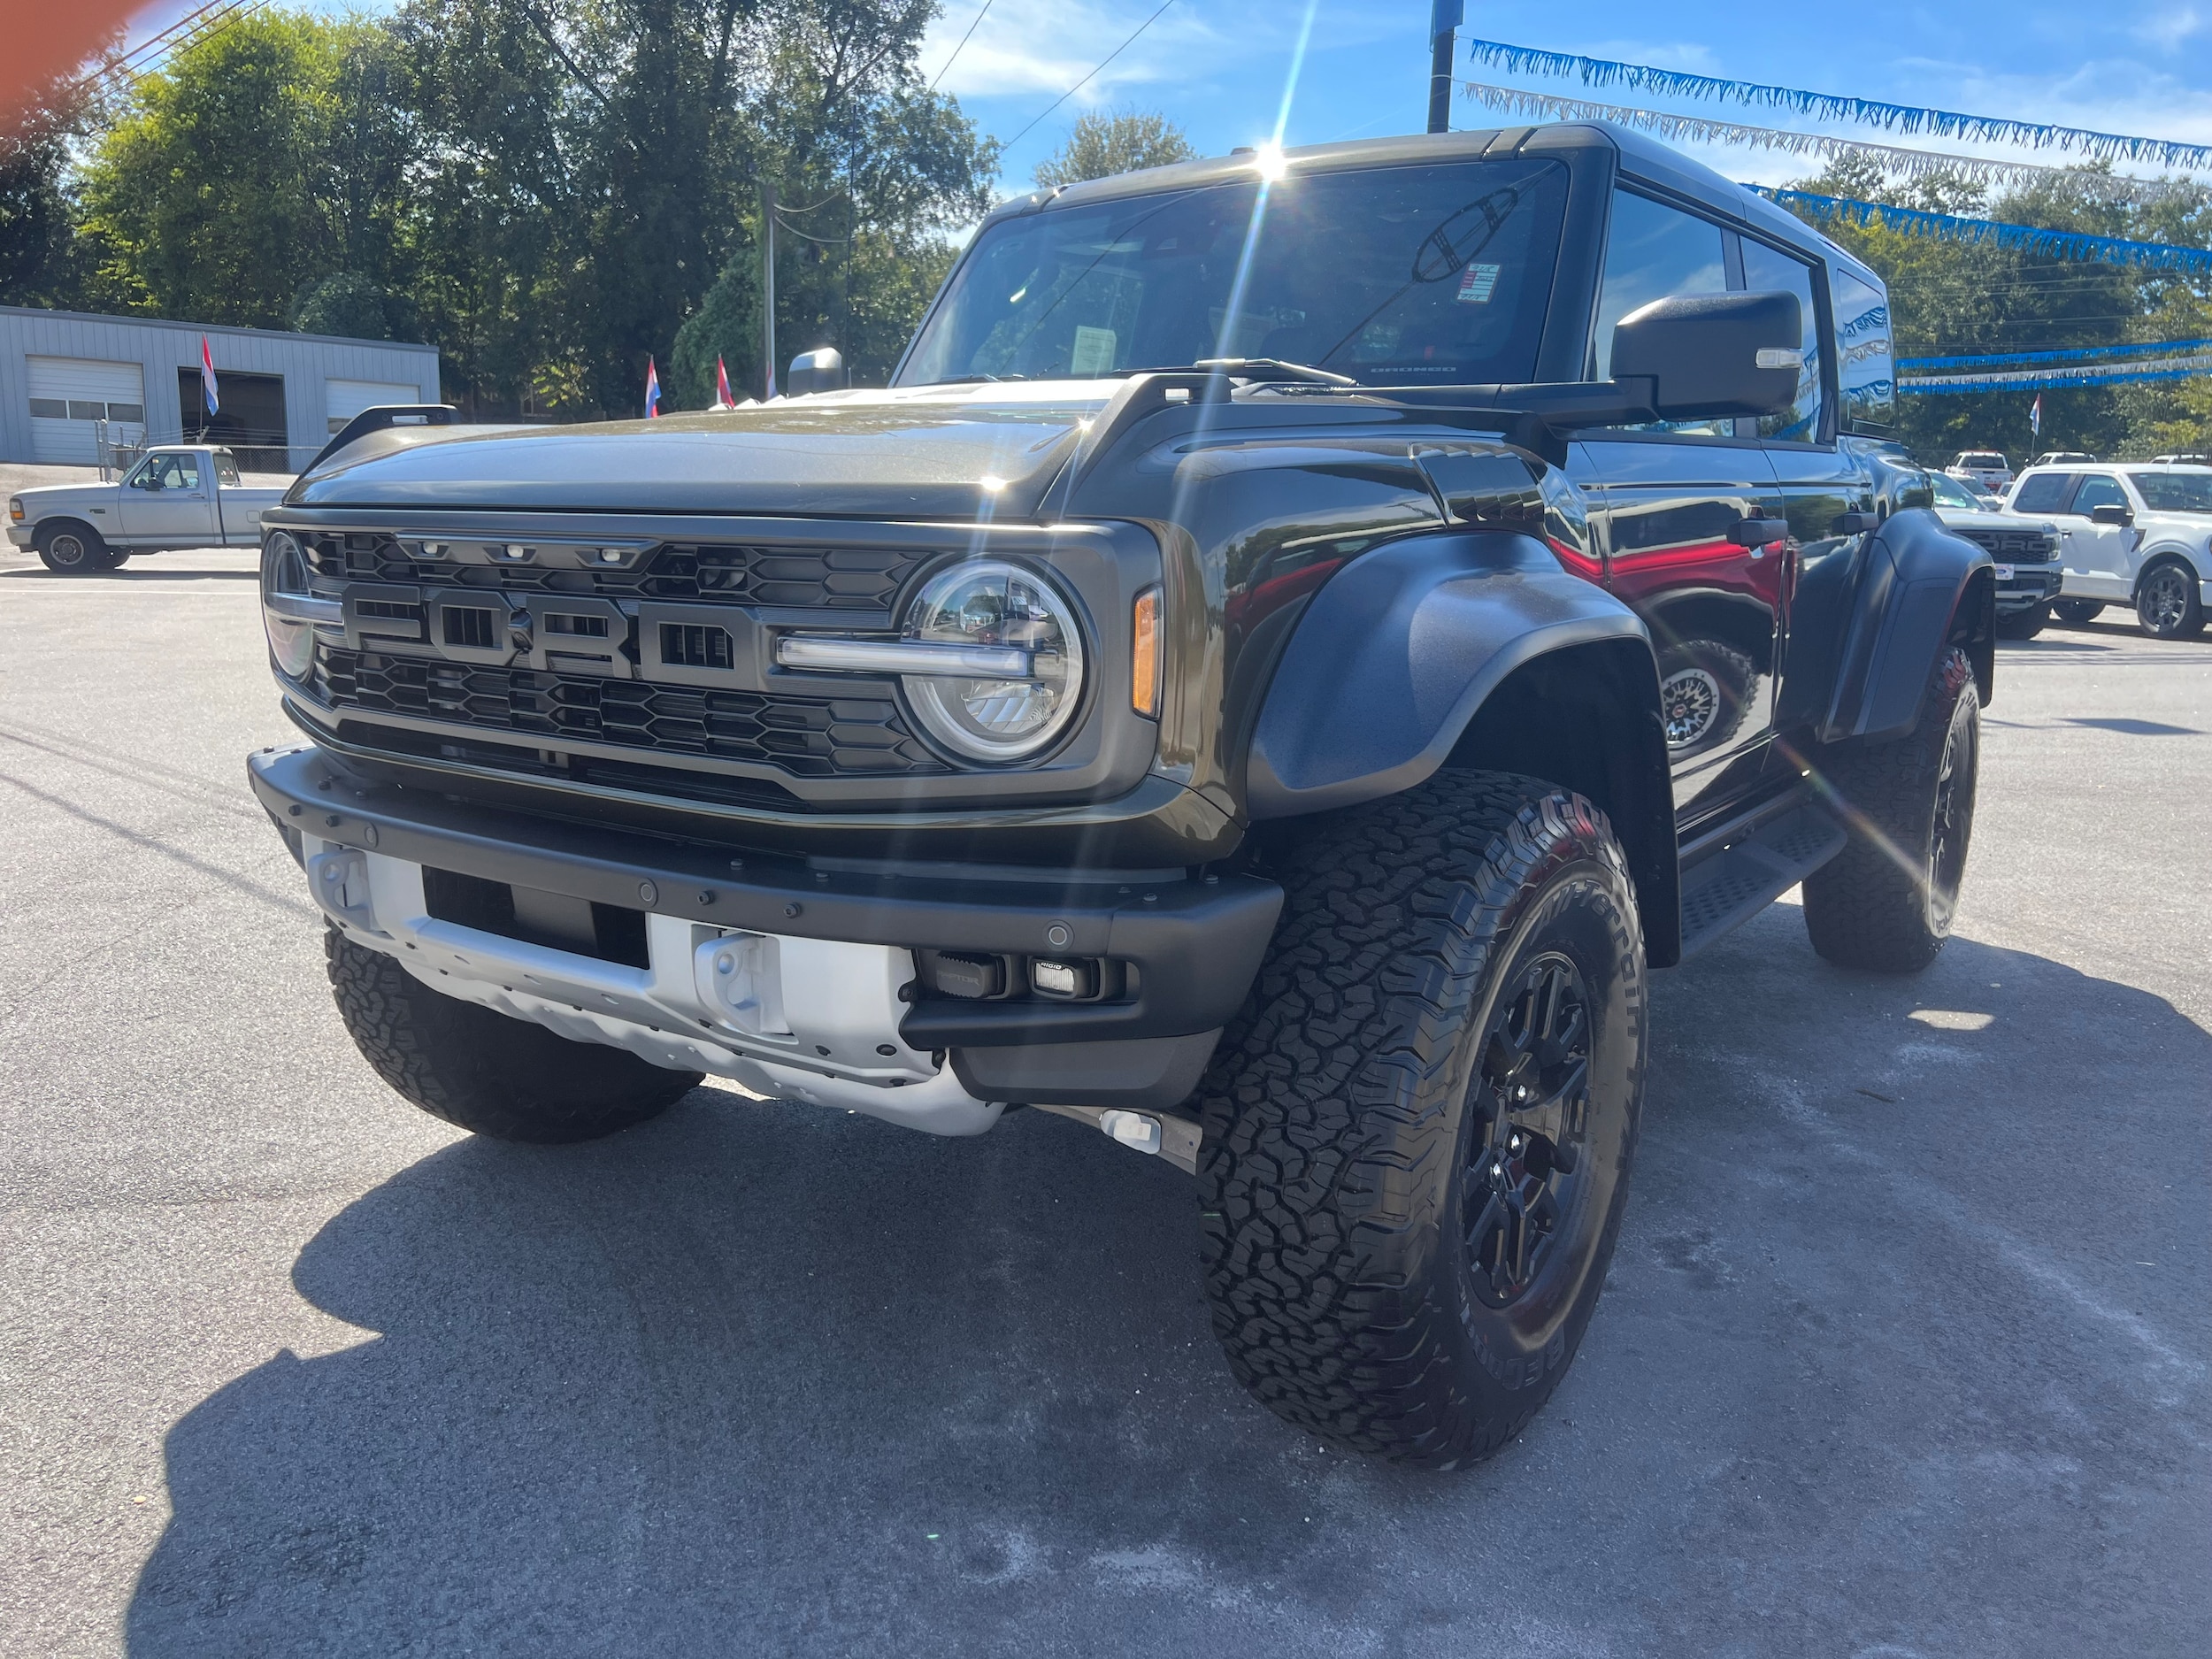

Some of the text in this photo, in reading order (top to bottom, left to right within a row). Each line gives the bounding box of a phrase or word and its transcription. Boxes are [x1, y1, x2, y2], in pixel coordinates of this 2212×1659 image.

[1978, 540, 2052, 551] ORD
[343, 582, 760, 691] FORD
[1530, 879, 1640, 1038] All-Terrain
